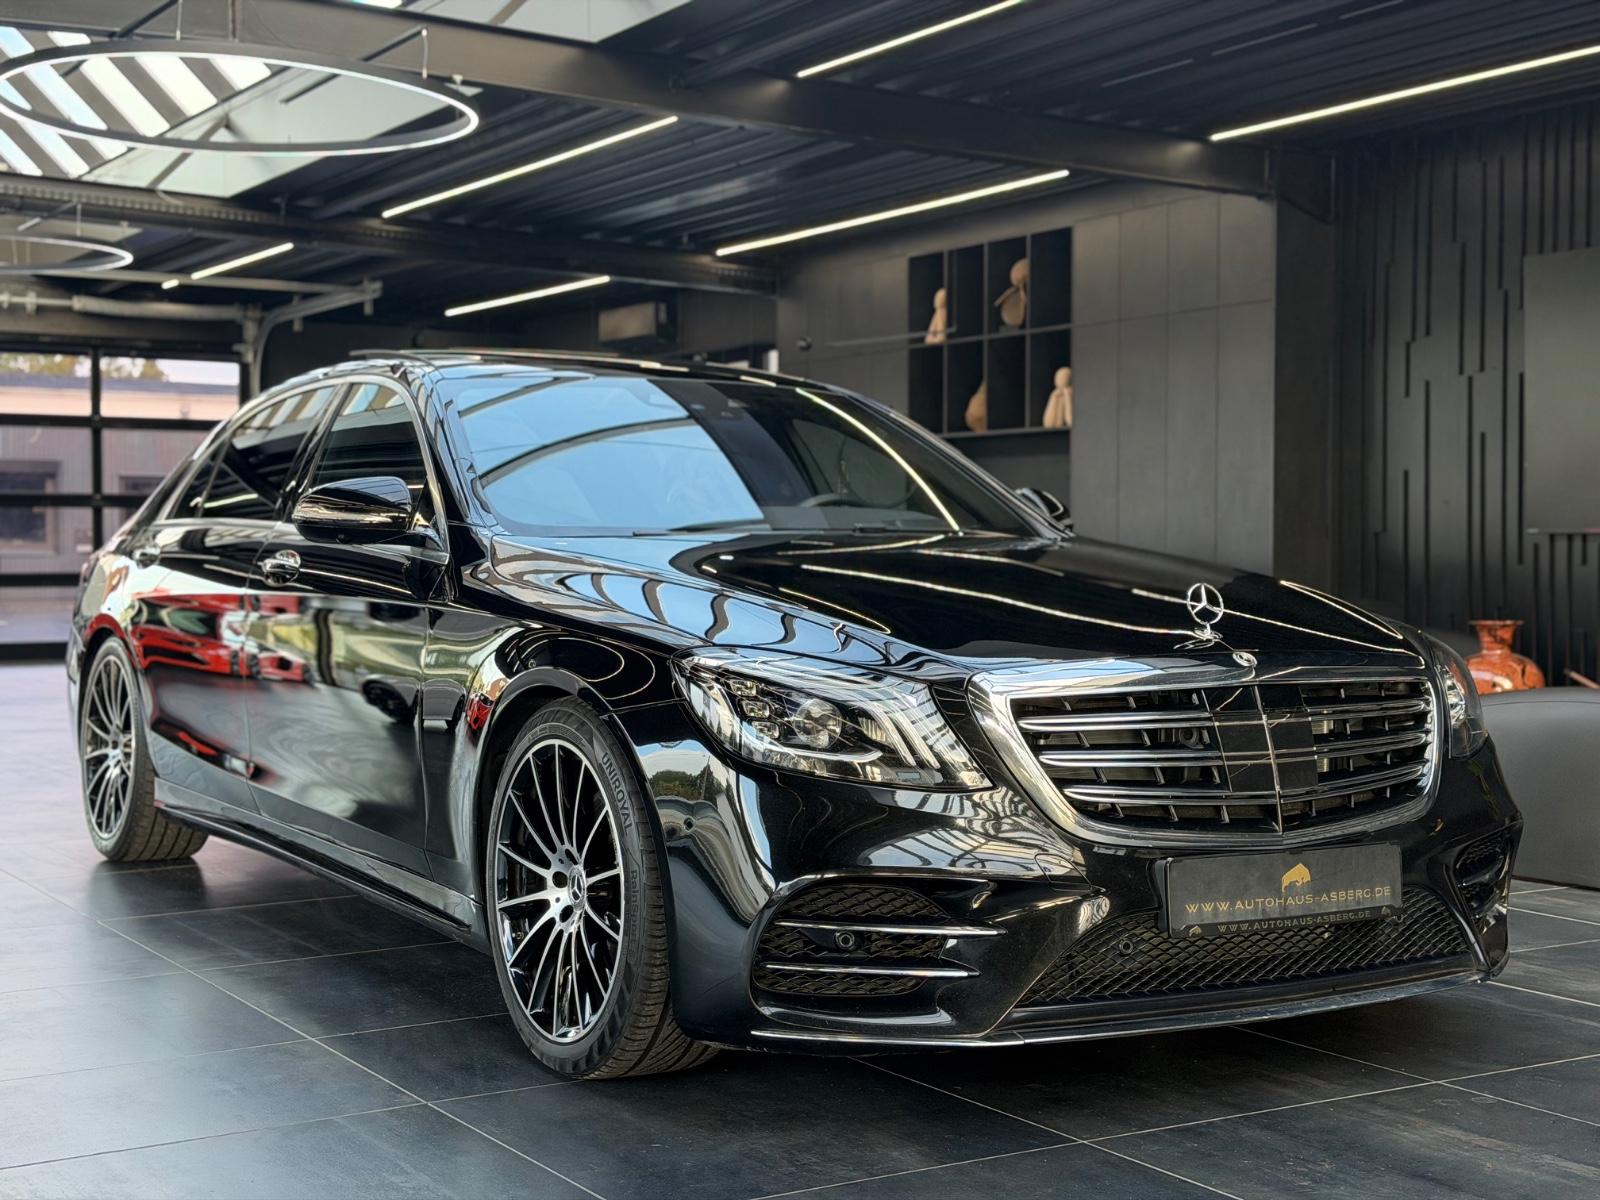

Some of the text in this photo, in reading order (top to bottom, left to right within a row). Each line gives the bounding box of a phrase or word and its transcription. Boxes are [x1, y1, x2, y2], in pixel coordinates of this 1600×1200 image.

[602, 751, 633, 837] UNIROYAL
[1184, 885, 1392, 913] WWW.AUTOHAUS-ASBERG.DE
[1217, 910, 1372, 933] WWW.AUTOHAUS-ASBERG.DE
